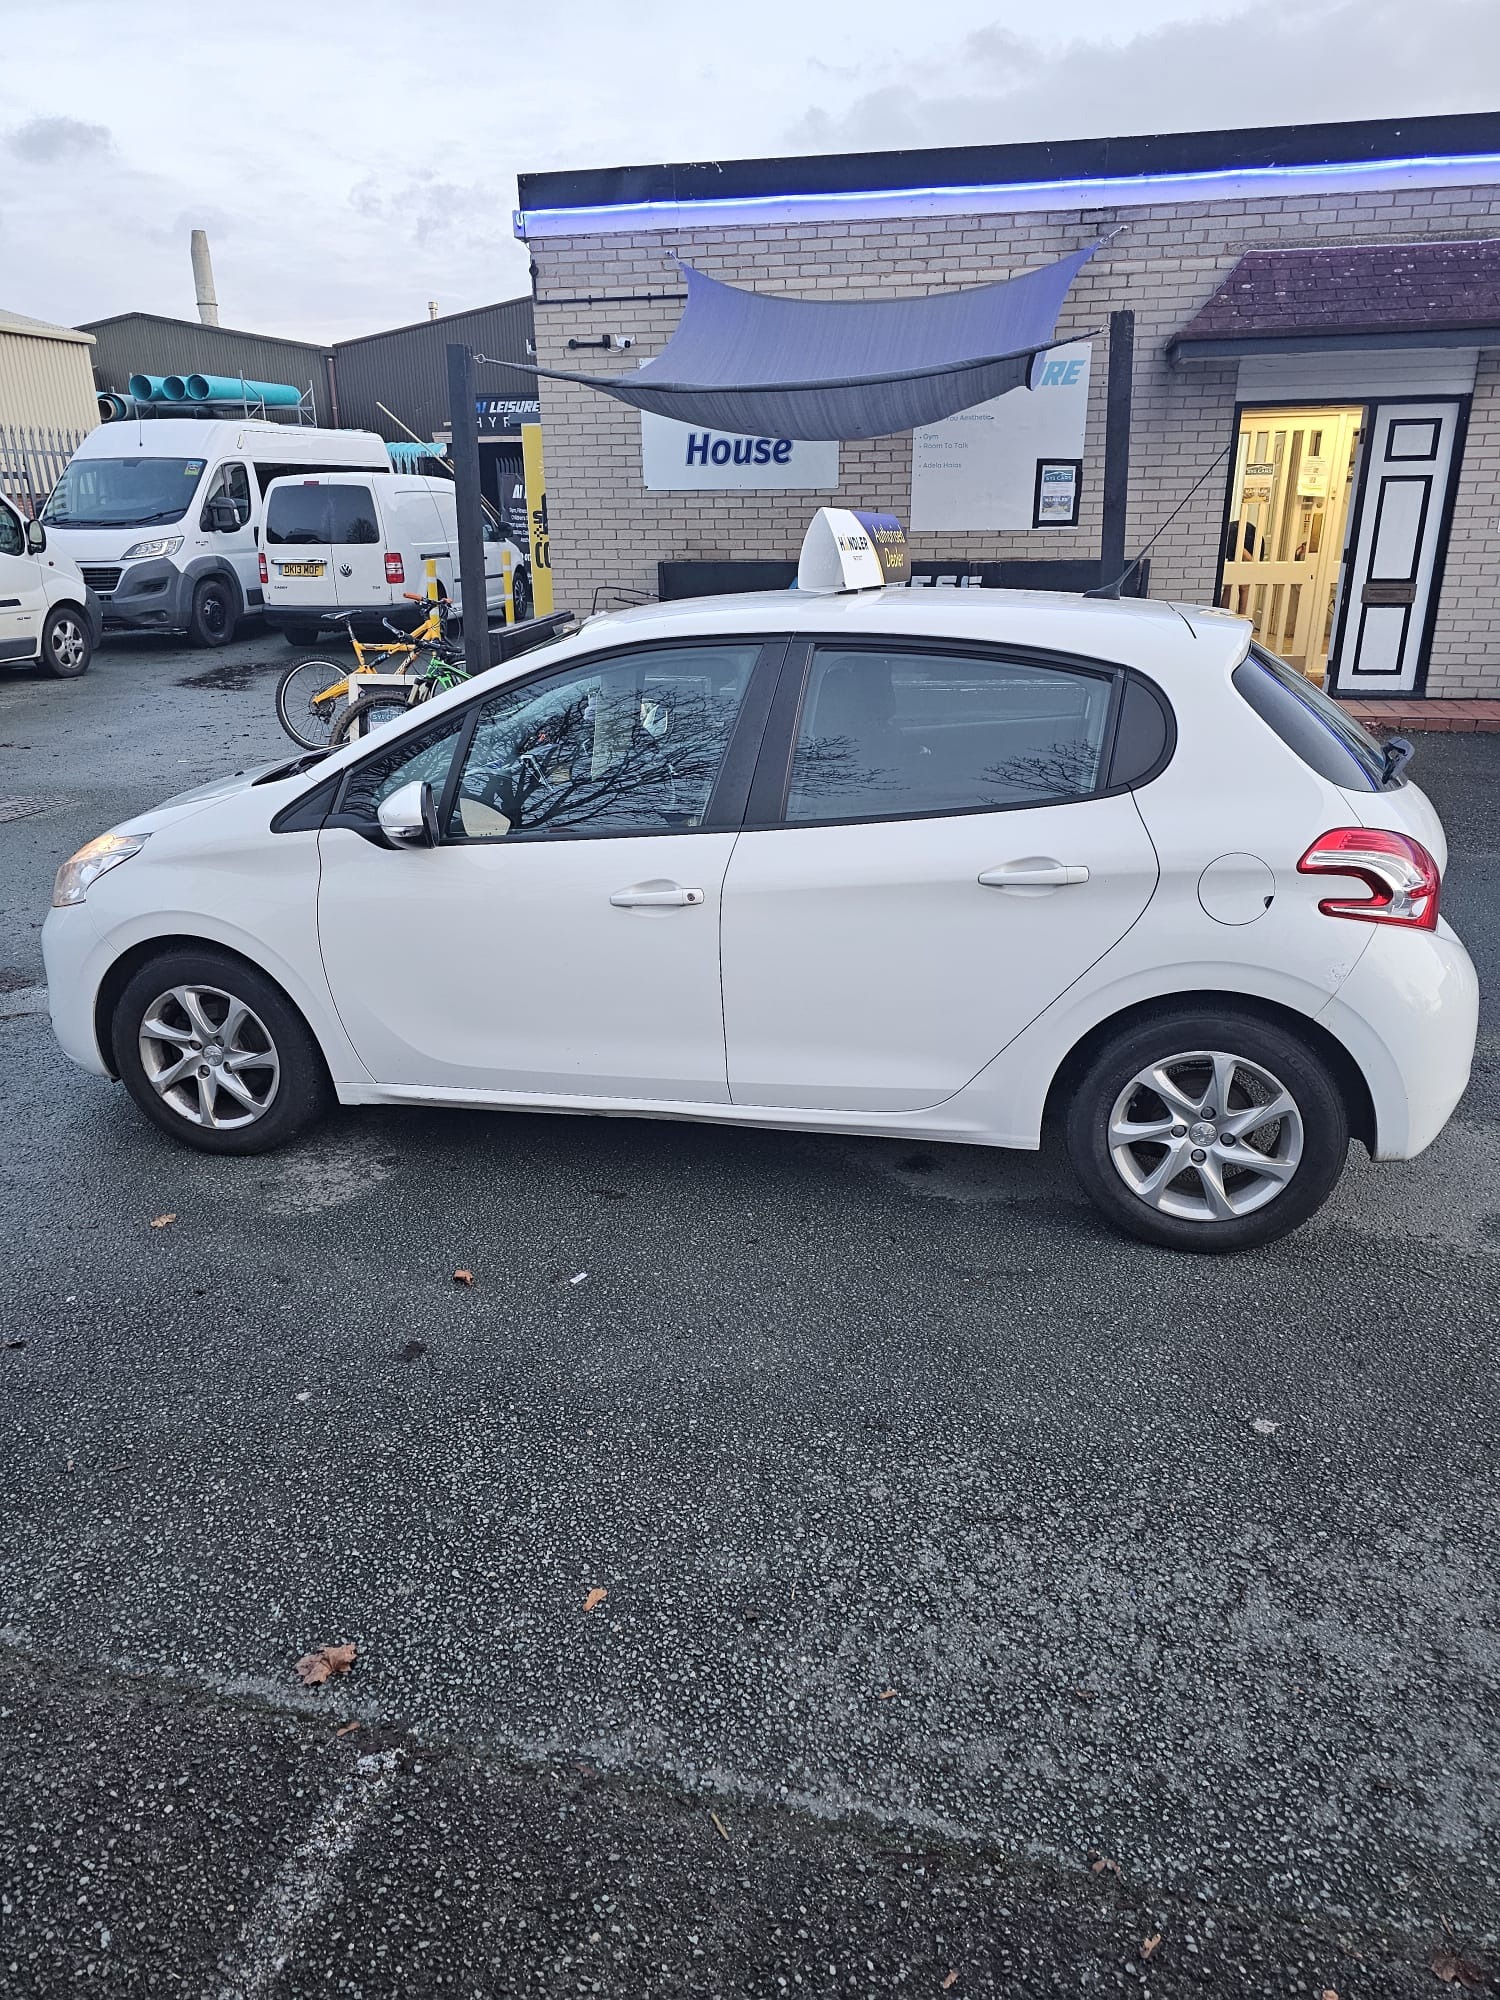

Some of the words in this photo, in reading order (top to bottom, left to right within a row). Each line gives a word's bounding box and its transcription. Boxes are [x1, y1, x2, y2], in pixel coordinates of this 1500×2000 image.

[489, 400, 541, 413] LEISURE
[684, 431, 794, 466] House
[884, 546, 904, 568] Dealer
[284, 563, 303, 574] DK13
